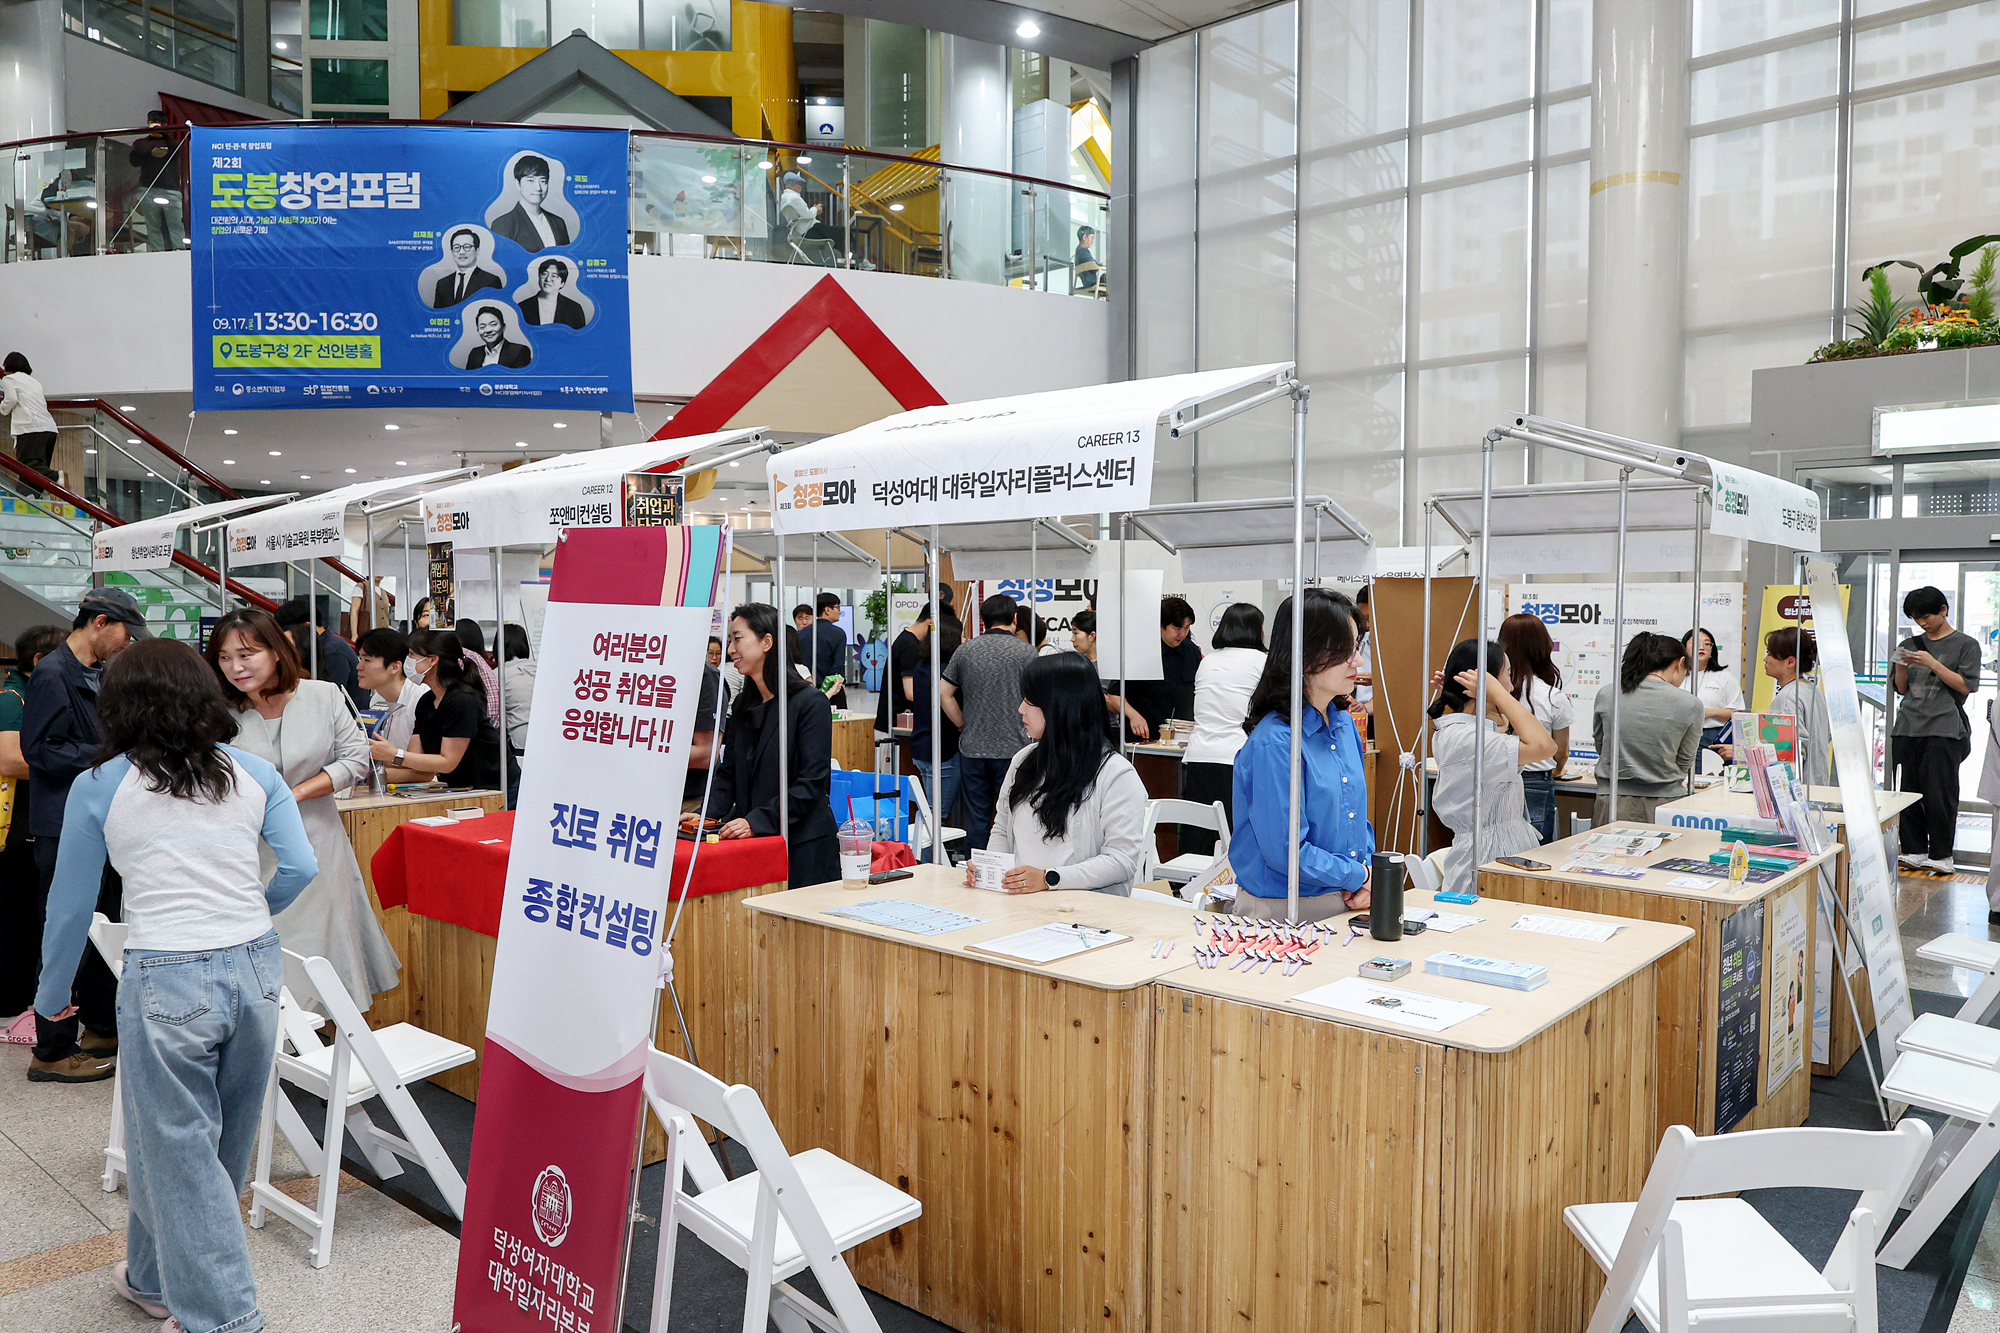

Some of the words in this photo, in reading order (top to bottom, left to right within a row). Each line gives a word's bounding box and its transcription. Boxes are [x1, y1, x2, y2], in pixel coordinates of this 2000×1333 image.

[212, 157, 242, 168] 제2회
[211, 171, 421, 209] 도봉창업포럼
[211, 226, 231, 234] 창업의
[232, 226, 252, 234] 새로운
[254, 226, 268, 234] 기회
[239, 216, 255, 225] 시대,
[256, 216, 276, 224] 기술과
[278, 216, 298, 224] 사회적
[300, 216, 321, 224] 가치가
[322, 216, 337, 224] 여는
[213, 318, 248, 330] 09.17.
[254, 312, 378, 331] 13:30-16:30
[235, 344, 289, 359] 도봉구청
[293, 344, 313, 358] 2F
[317, 343, 373, 359] 선인봉홀
[1077, 432, 1124, 448] CAREER
[1127, 430, 1140, 444] 13
[582, 485, 605, 496] CAREER
[606, 484, 613, 493] 12
[872, 476, 938, 506] 덕성여대
[942, 457, 1136, 500] 대학일자리플러스센터
[794, 479, 856, 509] 청정모아
[1725, 489, 1749, 516] 청정모아
[550, 503, 612, 526] 쪼앤미컨설팅
[636, 497, 676, 516] 취업과
[779, 502, 791, 510] 제3회
[436, 512, 470, 532] 청정모아
[1783, 508, 1796, 529] 도봉구
[236, 535, 256, 552] 청정모아
[266, 534, 281, 551] 서울시
[282, 530, 309, 549] 기술교육원
[310, 526, 340, 545] 북부캠퍼스
[431, 562, 449, 578] 취업과
[593, 632, 667, 665] 여러분의
[573, 670, 611, 702] 성공
[616, 671, 677, 709] 취업을
[549, 802, 598, 852] 진로
[606, 812, 662, 869] 취업
[522, 877, 658, 957] 종합컨설팅
[1733, 949, 1743, 968] 취업
[493, 1227, 595, 1315] 덕성여자대학교
